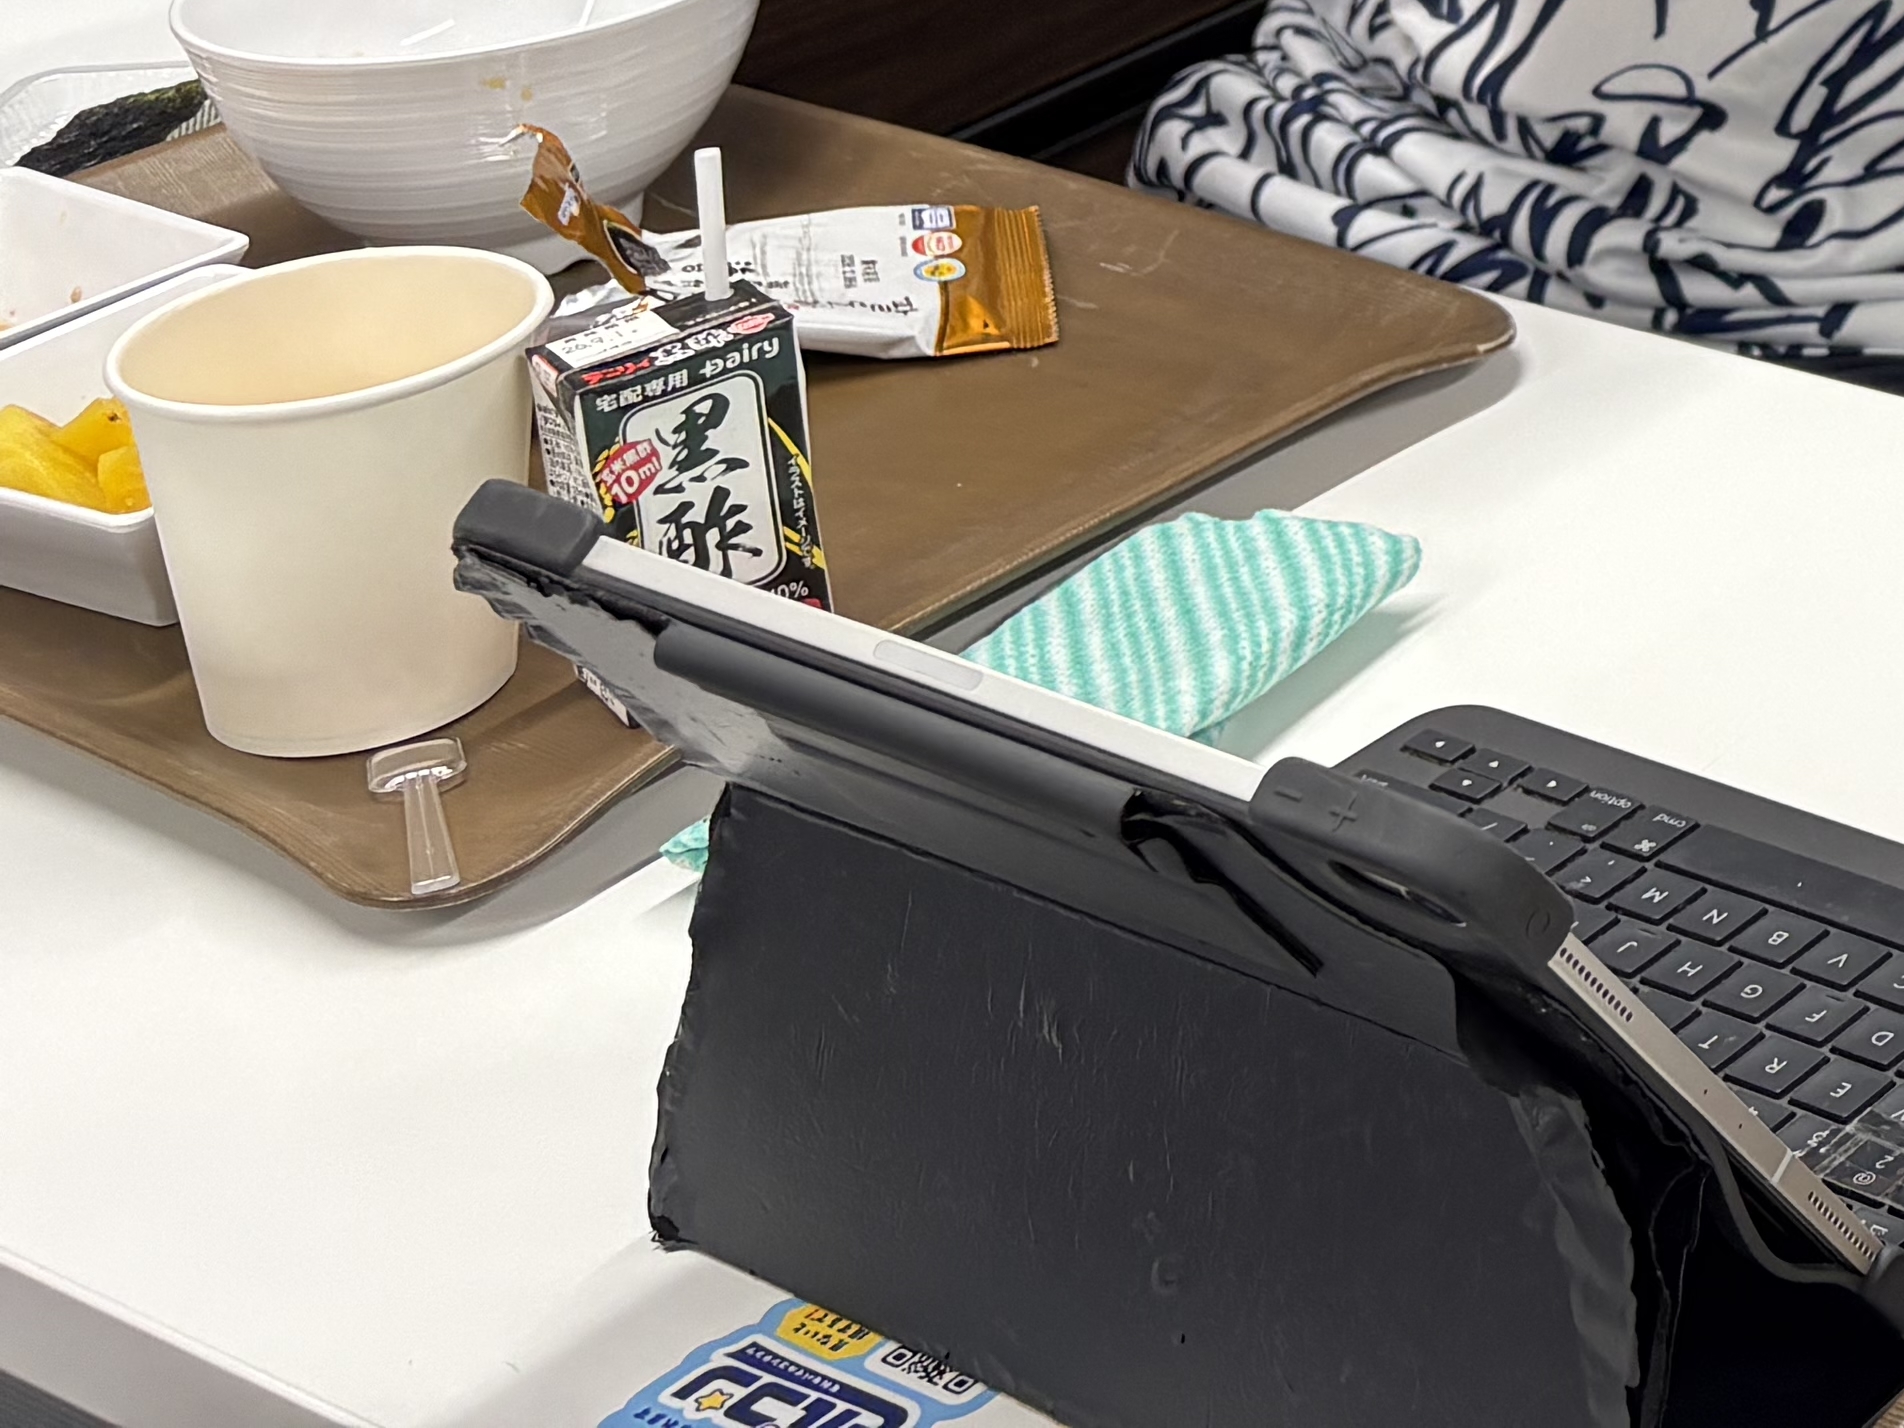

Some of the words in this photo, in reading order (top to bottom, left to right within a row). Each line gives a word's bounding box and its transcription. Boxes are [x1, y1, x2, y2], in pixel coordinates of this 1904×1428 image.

[595, 368, 690, 412] 宅配専用
[601, 438, 653, 487] 玄米黒酢
[611, 458, 663, 504] 10ml
[652, 392, 763, 580] 黒酢
[1589, 789, 1633, 810] option
[1652, 811, 1687, 829] cmd
